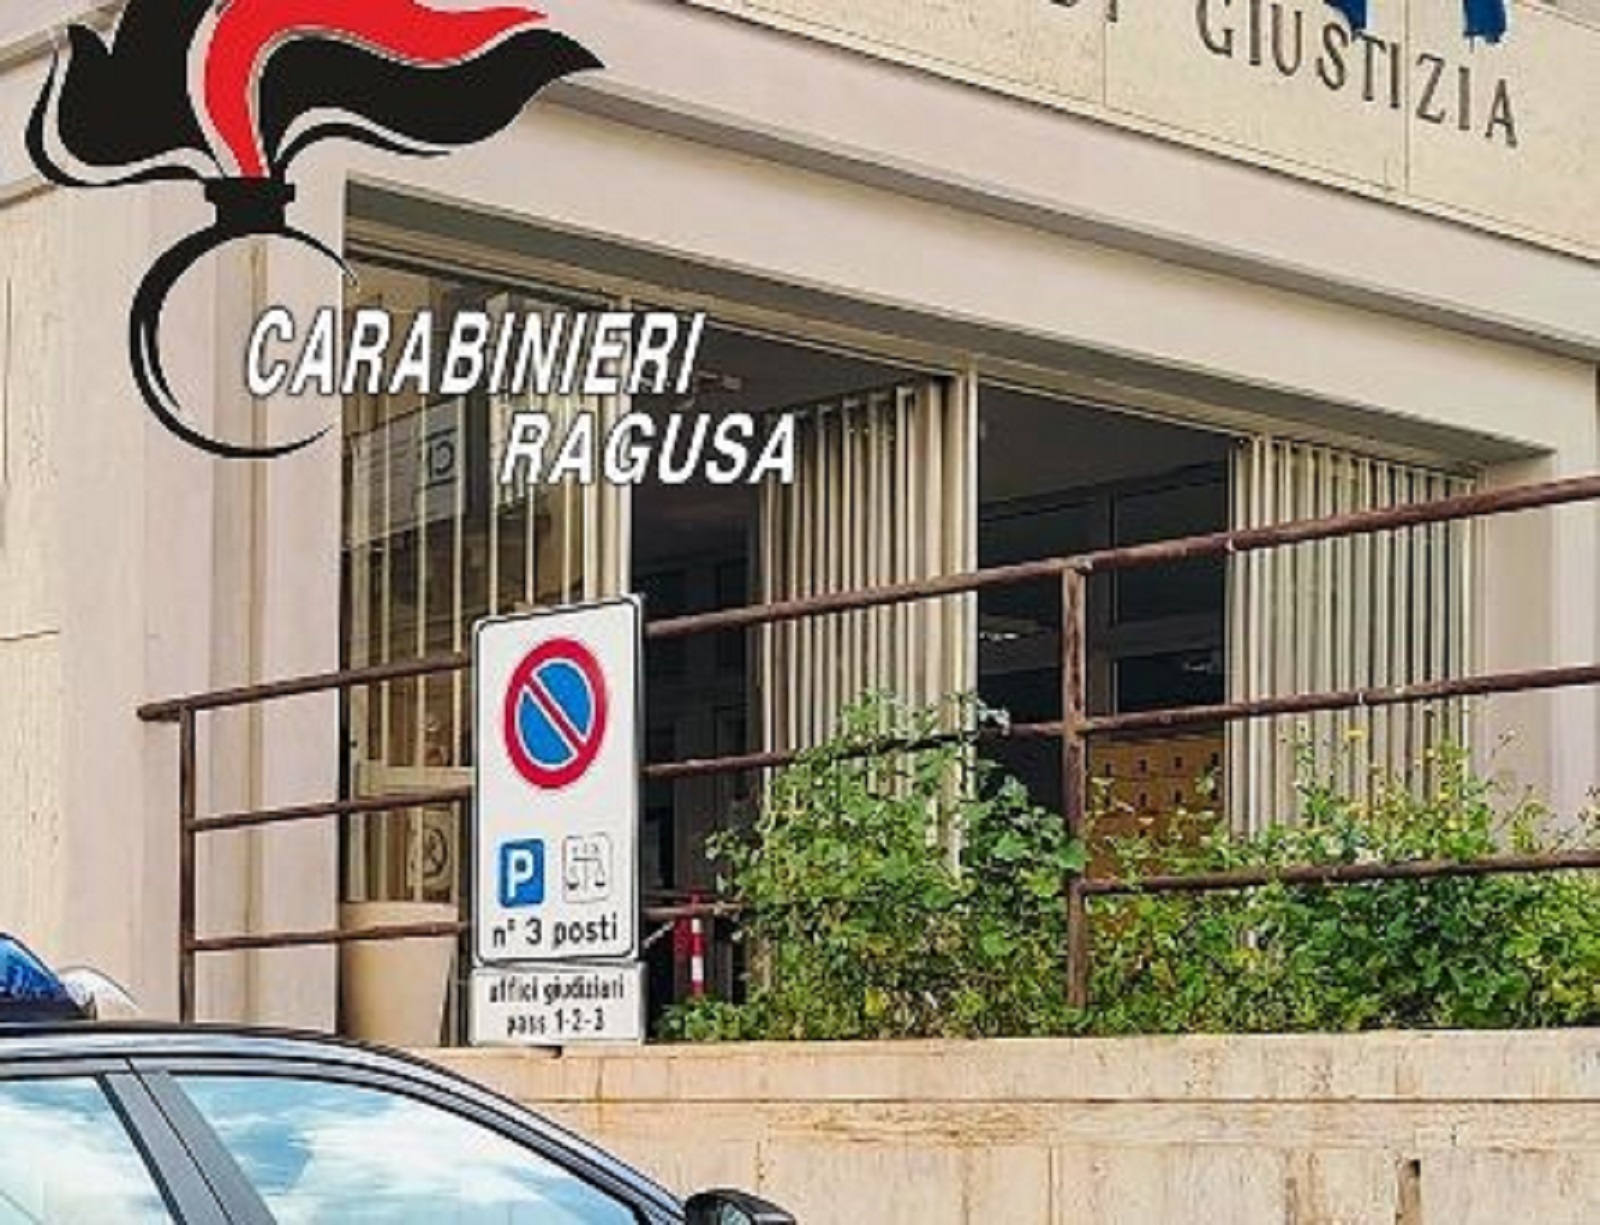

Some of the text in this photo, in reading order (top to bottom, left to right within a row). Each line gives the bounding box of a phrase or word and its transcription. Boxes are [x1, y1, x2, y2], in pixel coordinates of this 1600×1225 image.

[1197, 0, 1517, 148] GIUSTIZIA
[507, 848, 534, 899] P
[524, 918, 542, 945] 3
[553, 912, 617, 948] posti
